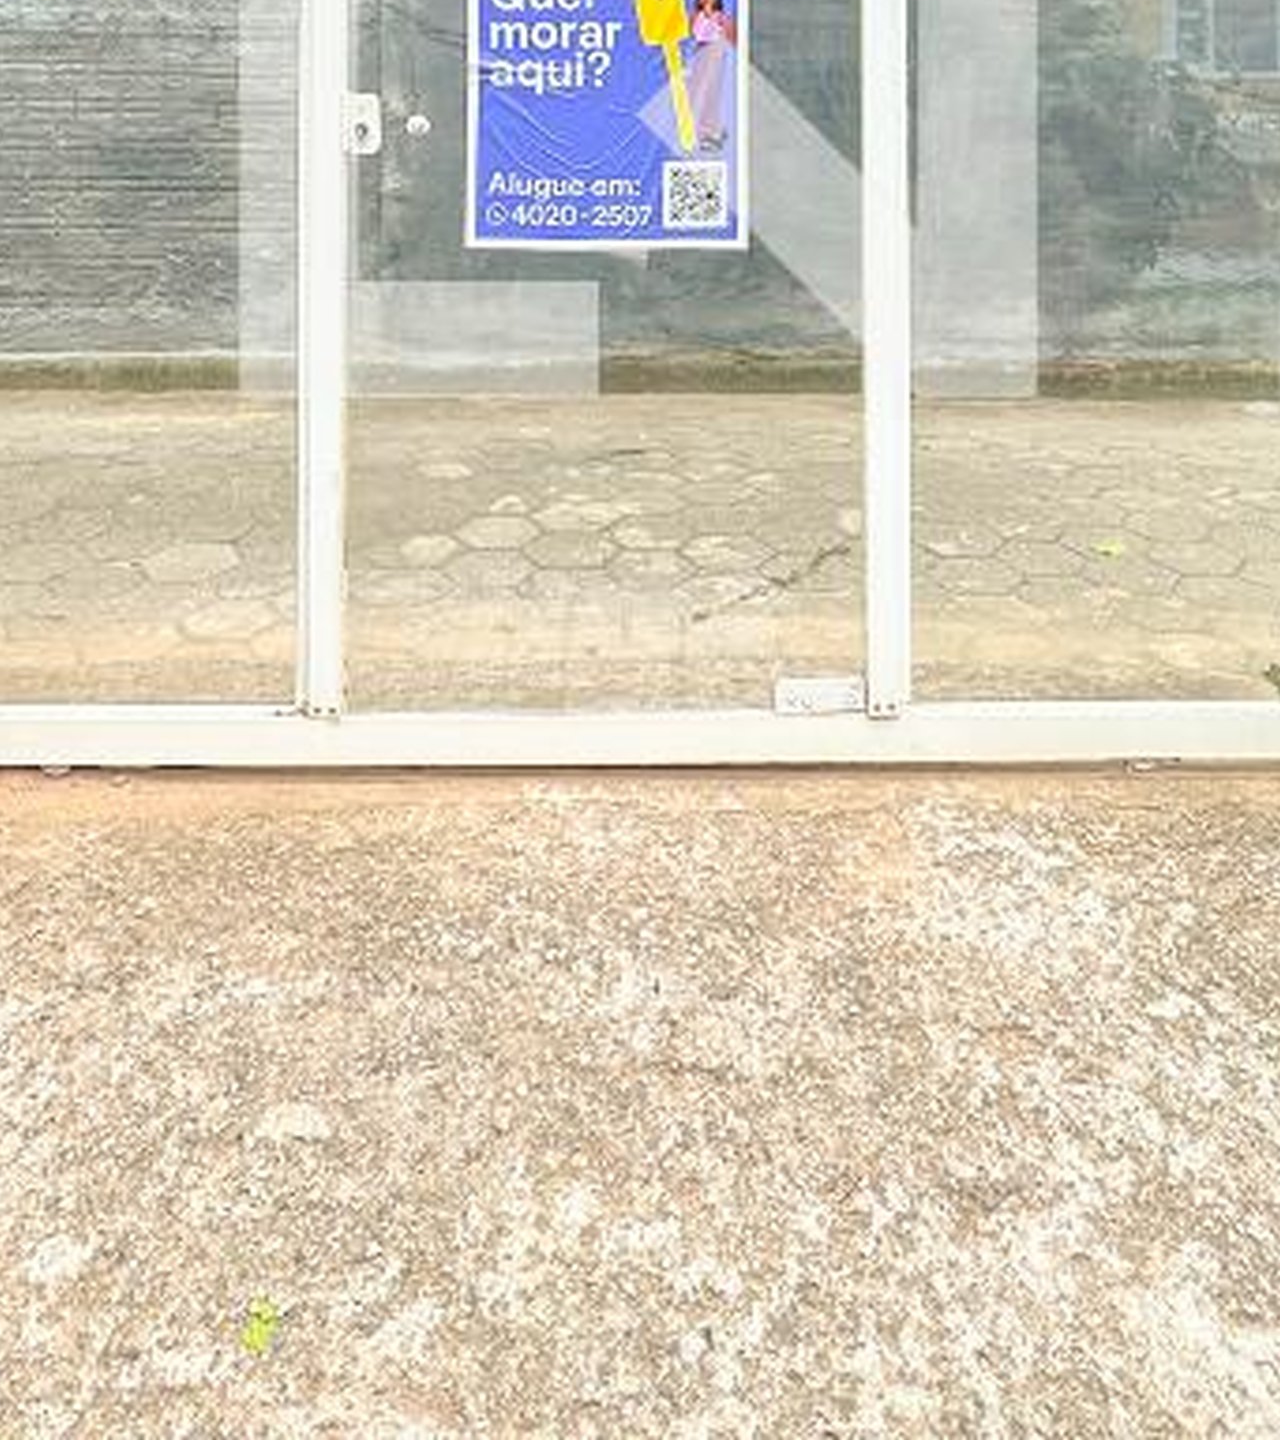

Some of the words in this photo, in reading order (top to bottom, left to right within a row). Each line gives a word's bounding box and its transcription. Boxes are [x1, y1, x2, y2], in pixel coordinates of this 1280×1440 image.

[489, 22, 621, 49] morar
[489, 51, 611, 94] aqui?
[489, 171, 585, 198] Alugue
